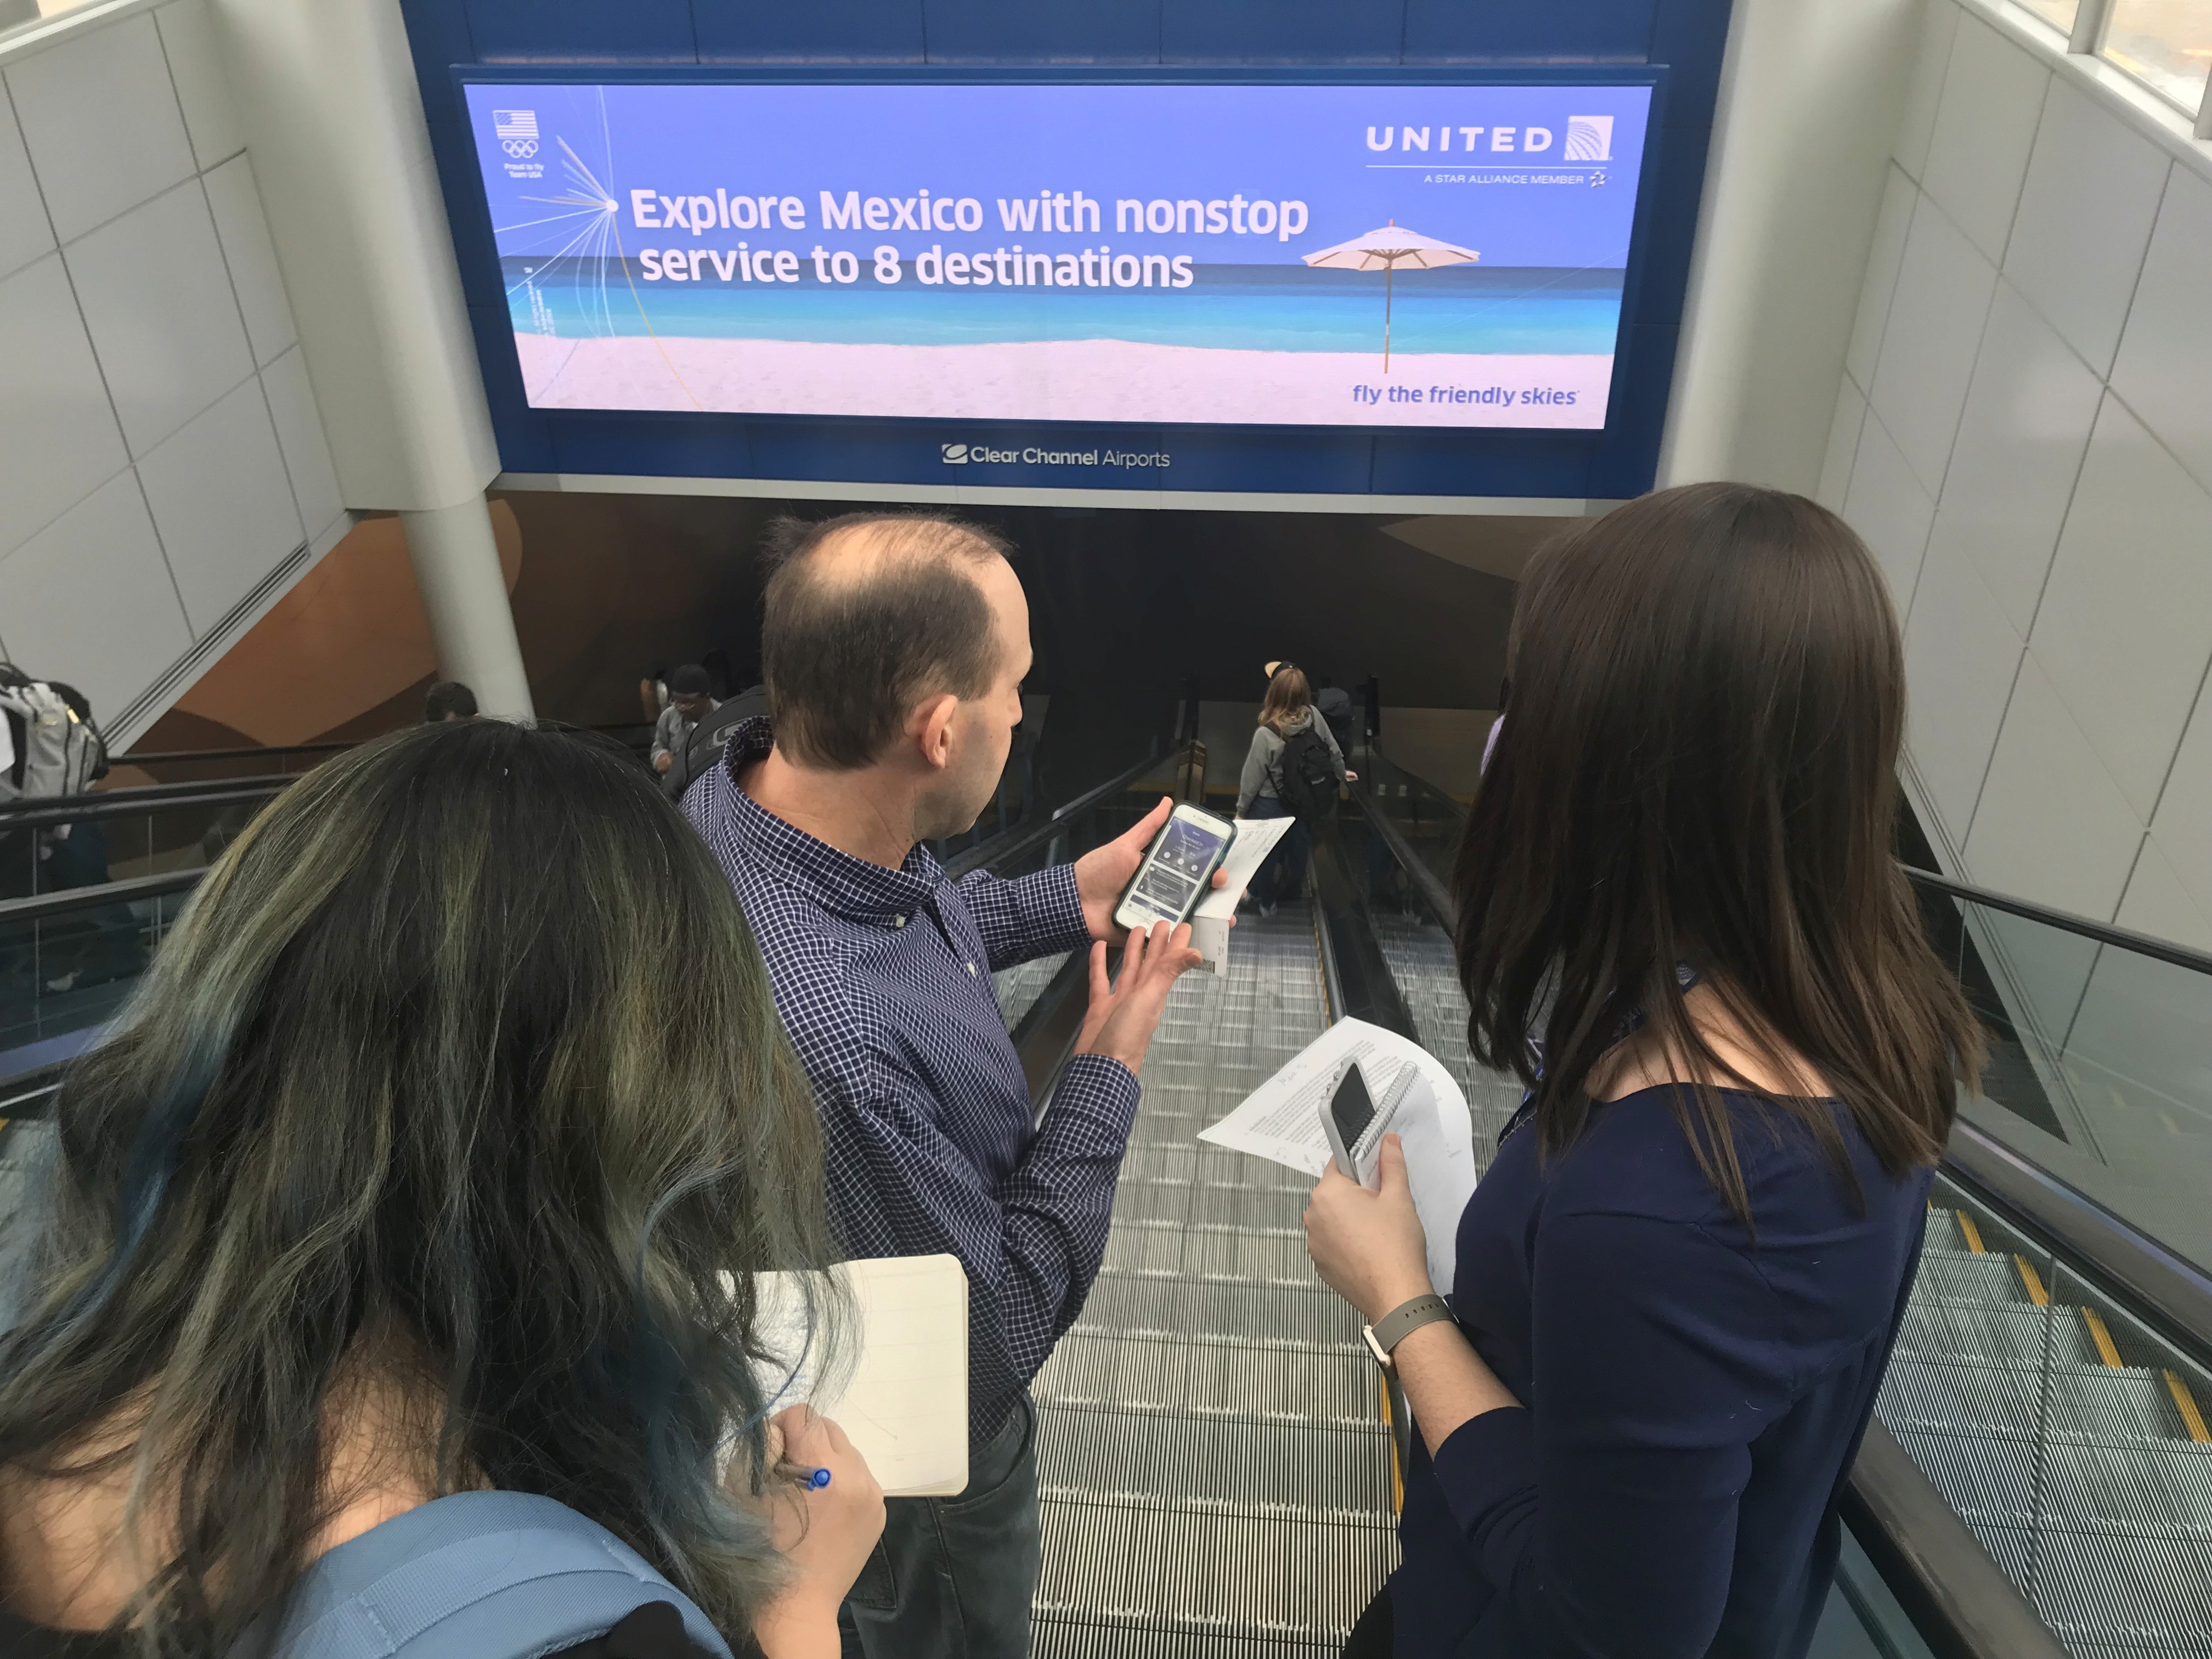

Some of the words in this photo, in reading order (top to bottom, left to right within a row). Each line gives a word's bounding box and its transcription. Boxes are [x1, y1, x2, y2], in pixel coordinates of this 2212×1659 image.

[1366, 126, 1553, 152] UNITED
[1424, 174, 1433, 183] A
[1435, 174, 1466, 184] STAR
[1468, 174, 1528, 184] ALLIANCE
[1531, 175, 1584, 185] MEMBER
[630, 188, 806, 236] Explore
[820, 189, 983, 232] Mexico
[997, 190, 1101, 233] with
[1116, 194, 1309, 242] nonstop
[639, 241, 800, 282] service
[811, 245, 860, 284] to
[874, 245, 902, 284] 8
[916, 245, 1194, 288] destinations
[1353, 385, 1383, 405] fly
[1388, 386, 1424, 403] the
[1429, 386, 1517, 408] friendly
[1520, 387, 1577, 405] skies
[970, 446, 1020, 464] Clear
[1022, 447, 1098, 466] Channel
[1102, 449, 1171, 470] Airports
